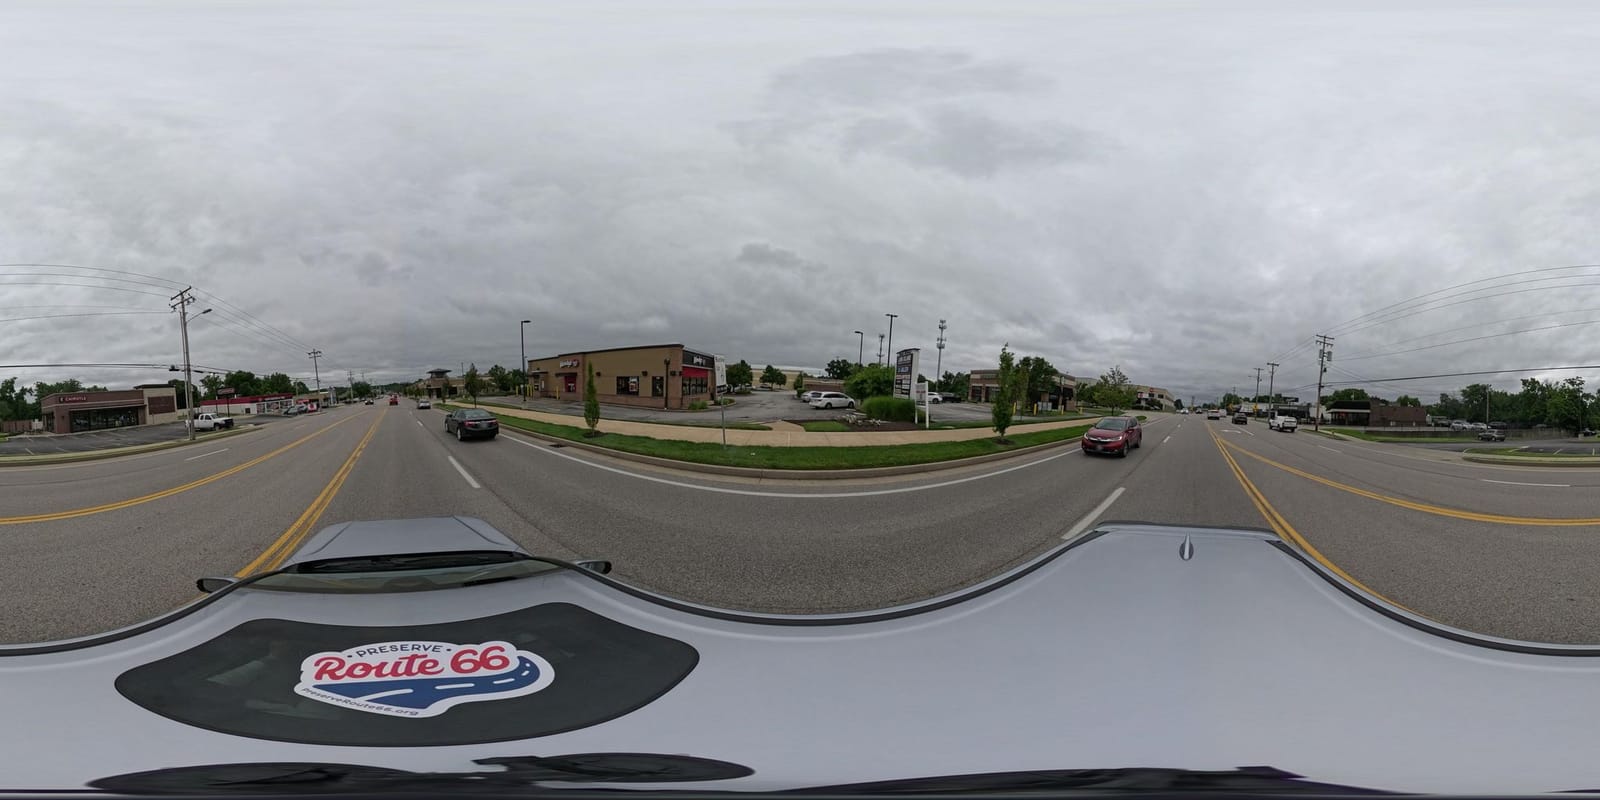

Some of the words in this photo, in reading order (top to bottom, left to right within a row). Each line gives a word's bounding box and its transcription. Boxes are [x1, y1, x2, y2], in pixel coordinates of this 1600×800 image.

[314, 653, 445, 681] Route
[450, 645, 510, 674] 66
[356, 643, 443, 658] PRESERVE
[302, 687, 419, 716] PreserveRoute66.org
